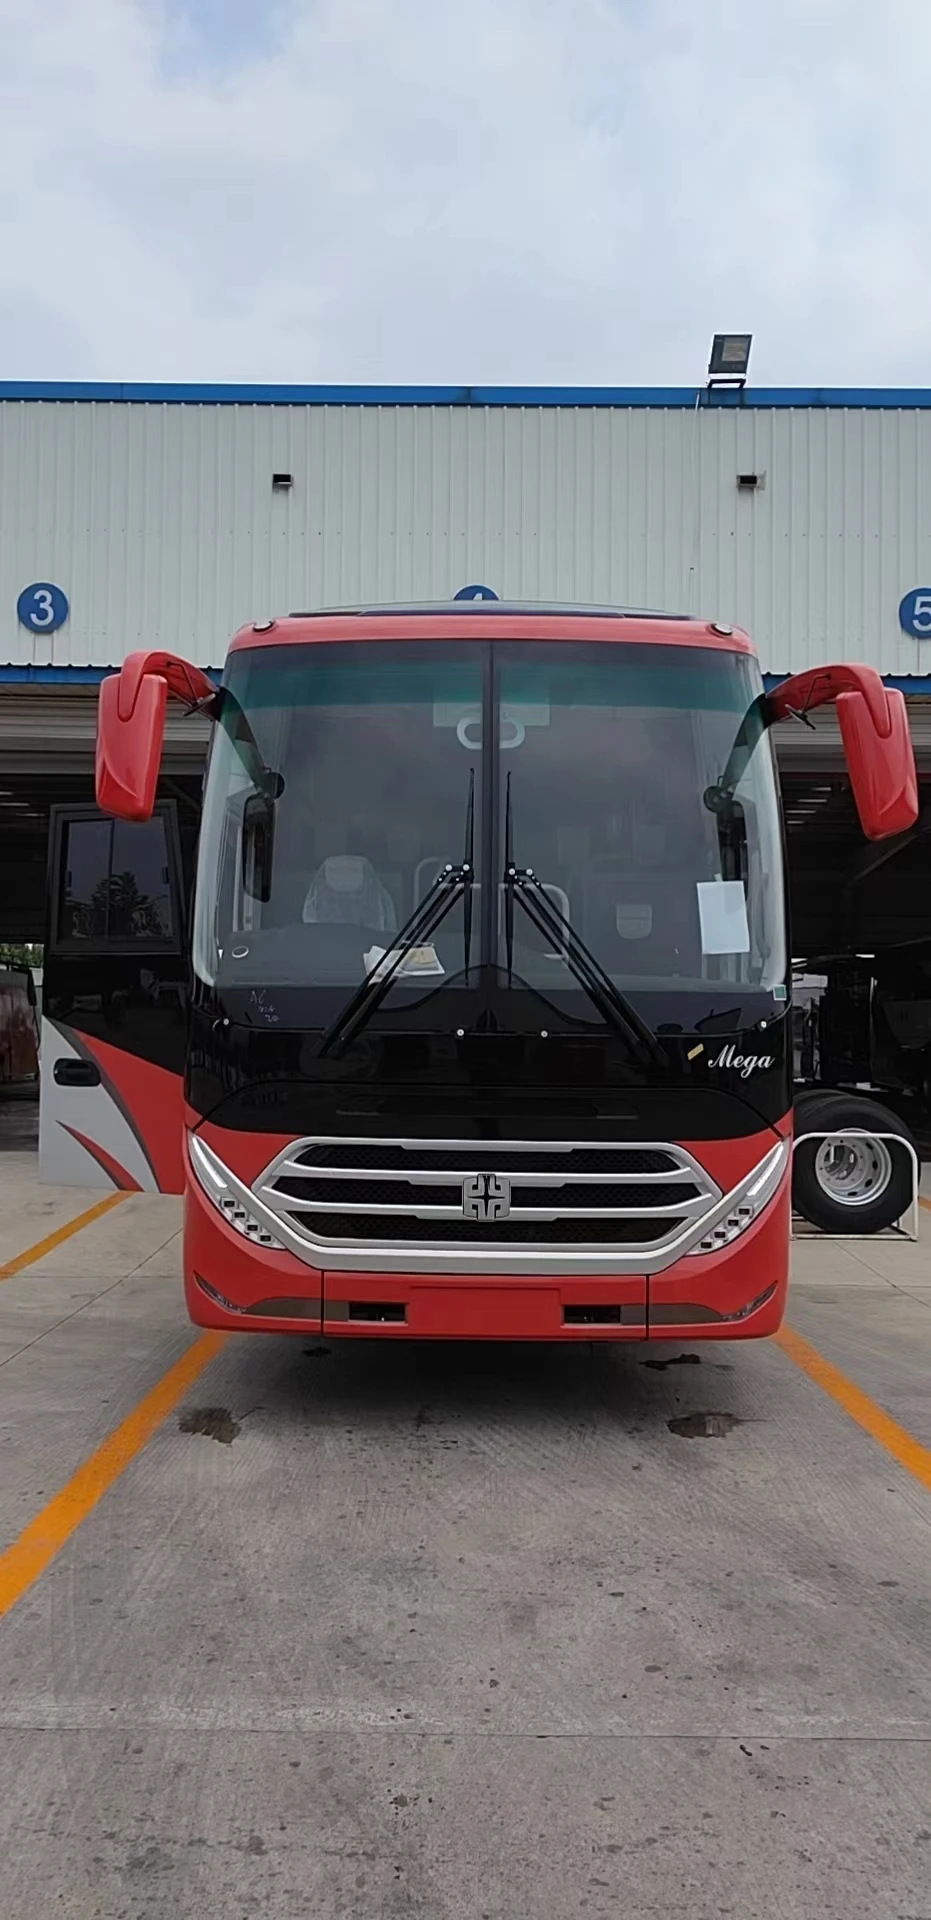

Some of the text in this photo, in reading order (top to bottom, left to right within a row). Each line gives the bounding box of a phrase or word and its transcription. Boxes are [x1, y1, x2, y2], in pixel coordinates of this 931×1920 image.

[30, 589, 54, 626] 3
[912, 596, 931, 631] 5
[707, 1044, 776, 1079] Mega
